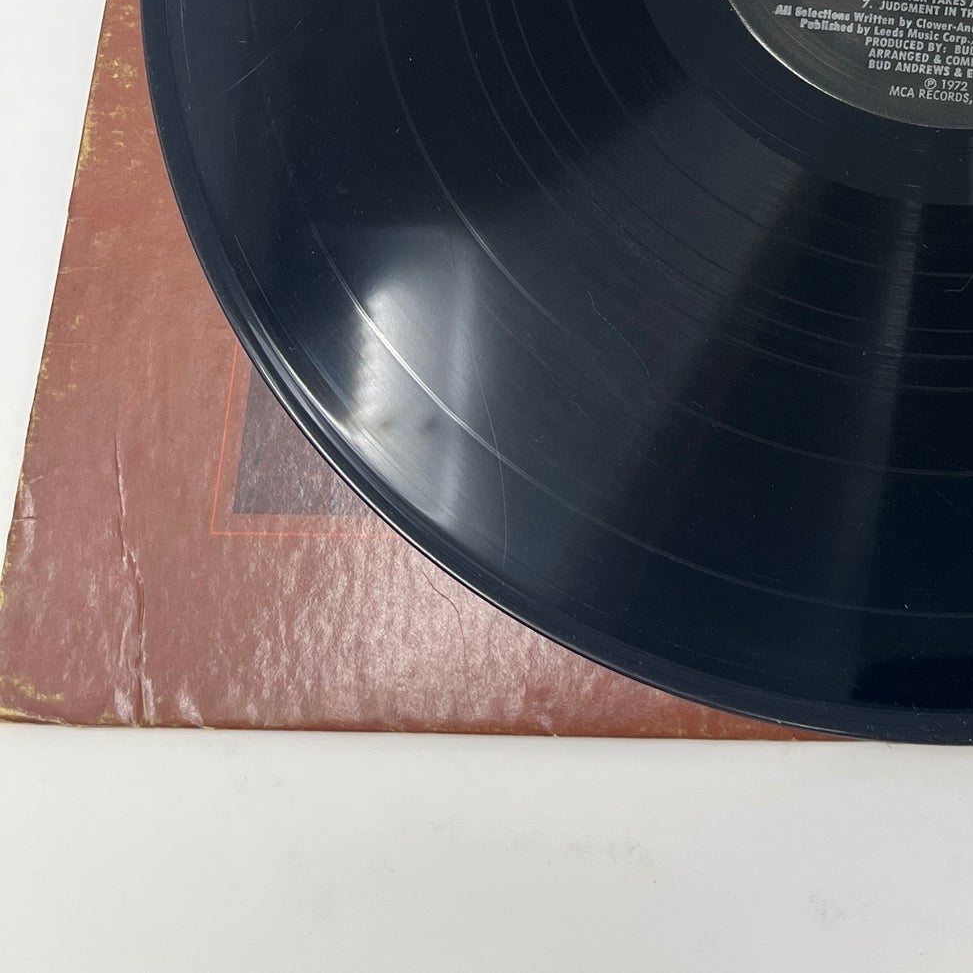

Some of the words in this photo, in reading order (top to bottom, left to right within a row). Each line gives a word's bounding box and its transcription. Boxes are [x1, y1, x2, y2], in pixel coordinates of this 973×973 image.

[775, 5, 791, 16] All
[795, 6, 850, 21] Selections
[854, 12, 894, 25] Written
[900, 16, 912, 28] by
[862, 0, 872, 9] 7.
[879, 1, 940, 15] JUDGMENT
[944, 7, 956, 17] IN
[800, 18, 853, 33] Published
[857, 24, 870, 35] by
[874, 26, 903, 38] Leeds
[908, 29, 939, 40] Music
[865, 37, 924, 50] PRODUCED
[928, 43, 946, 53] BY:
[868, 48, 929, 63] ARRANGED
[933, 55, 941, 64] &
[868, 59, 891, 70] BUD
[895, 62, 949, 76] ANDREWS
[954, 69, 962, 77] &
[941, 79, 968, 91] 1972
[889, 85, 915, 98] MCA
[919, 90, 973, 105] RECORDS,
